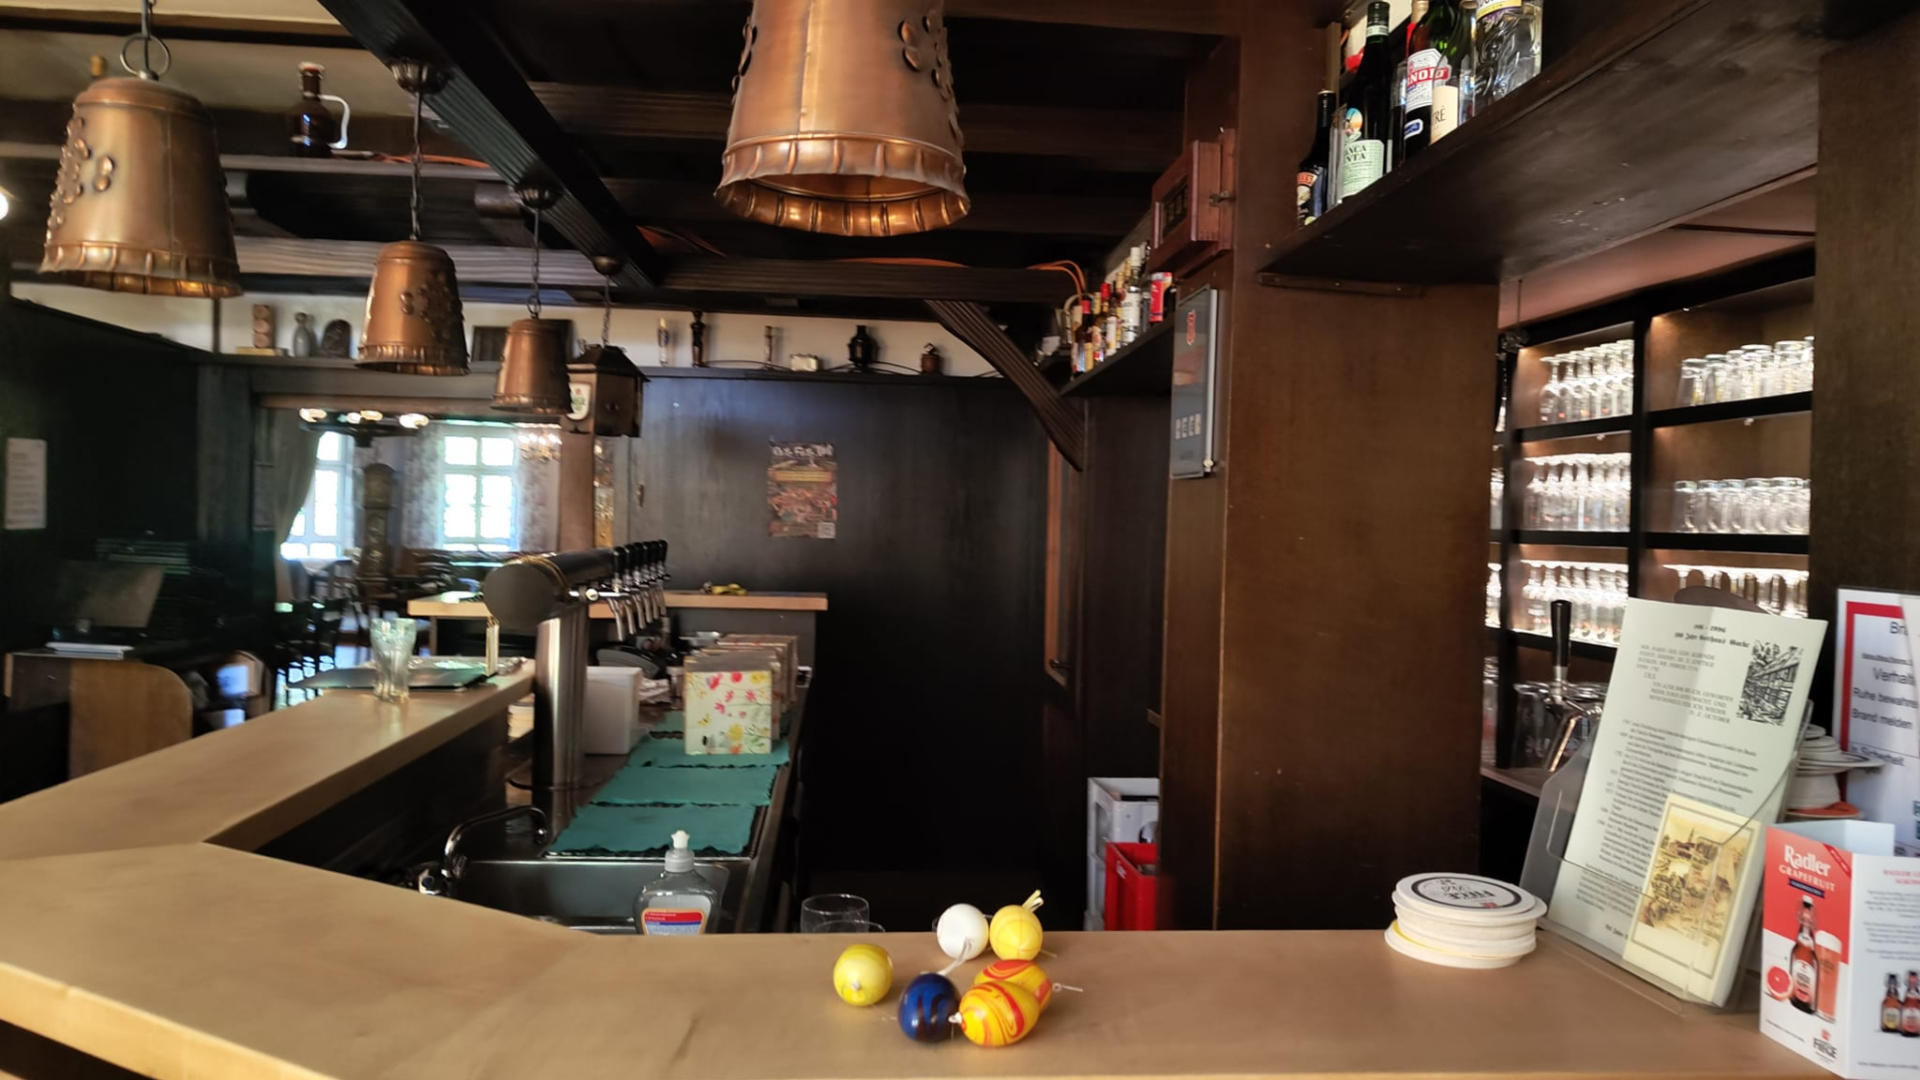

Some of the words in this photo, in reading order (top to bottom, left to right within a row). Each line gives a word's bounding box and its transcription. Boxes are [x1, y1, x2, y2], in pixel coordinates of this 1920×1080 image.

[1853, 687, 1876, 701] Ruhe
[1852, 708, 1878, 723] Brand
[1879, 715, 1913, 730] melden
[1784, 844, 1831, 877] Radler
[1779, 864, 1836, 892] GRAPEFRUIT
